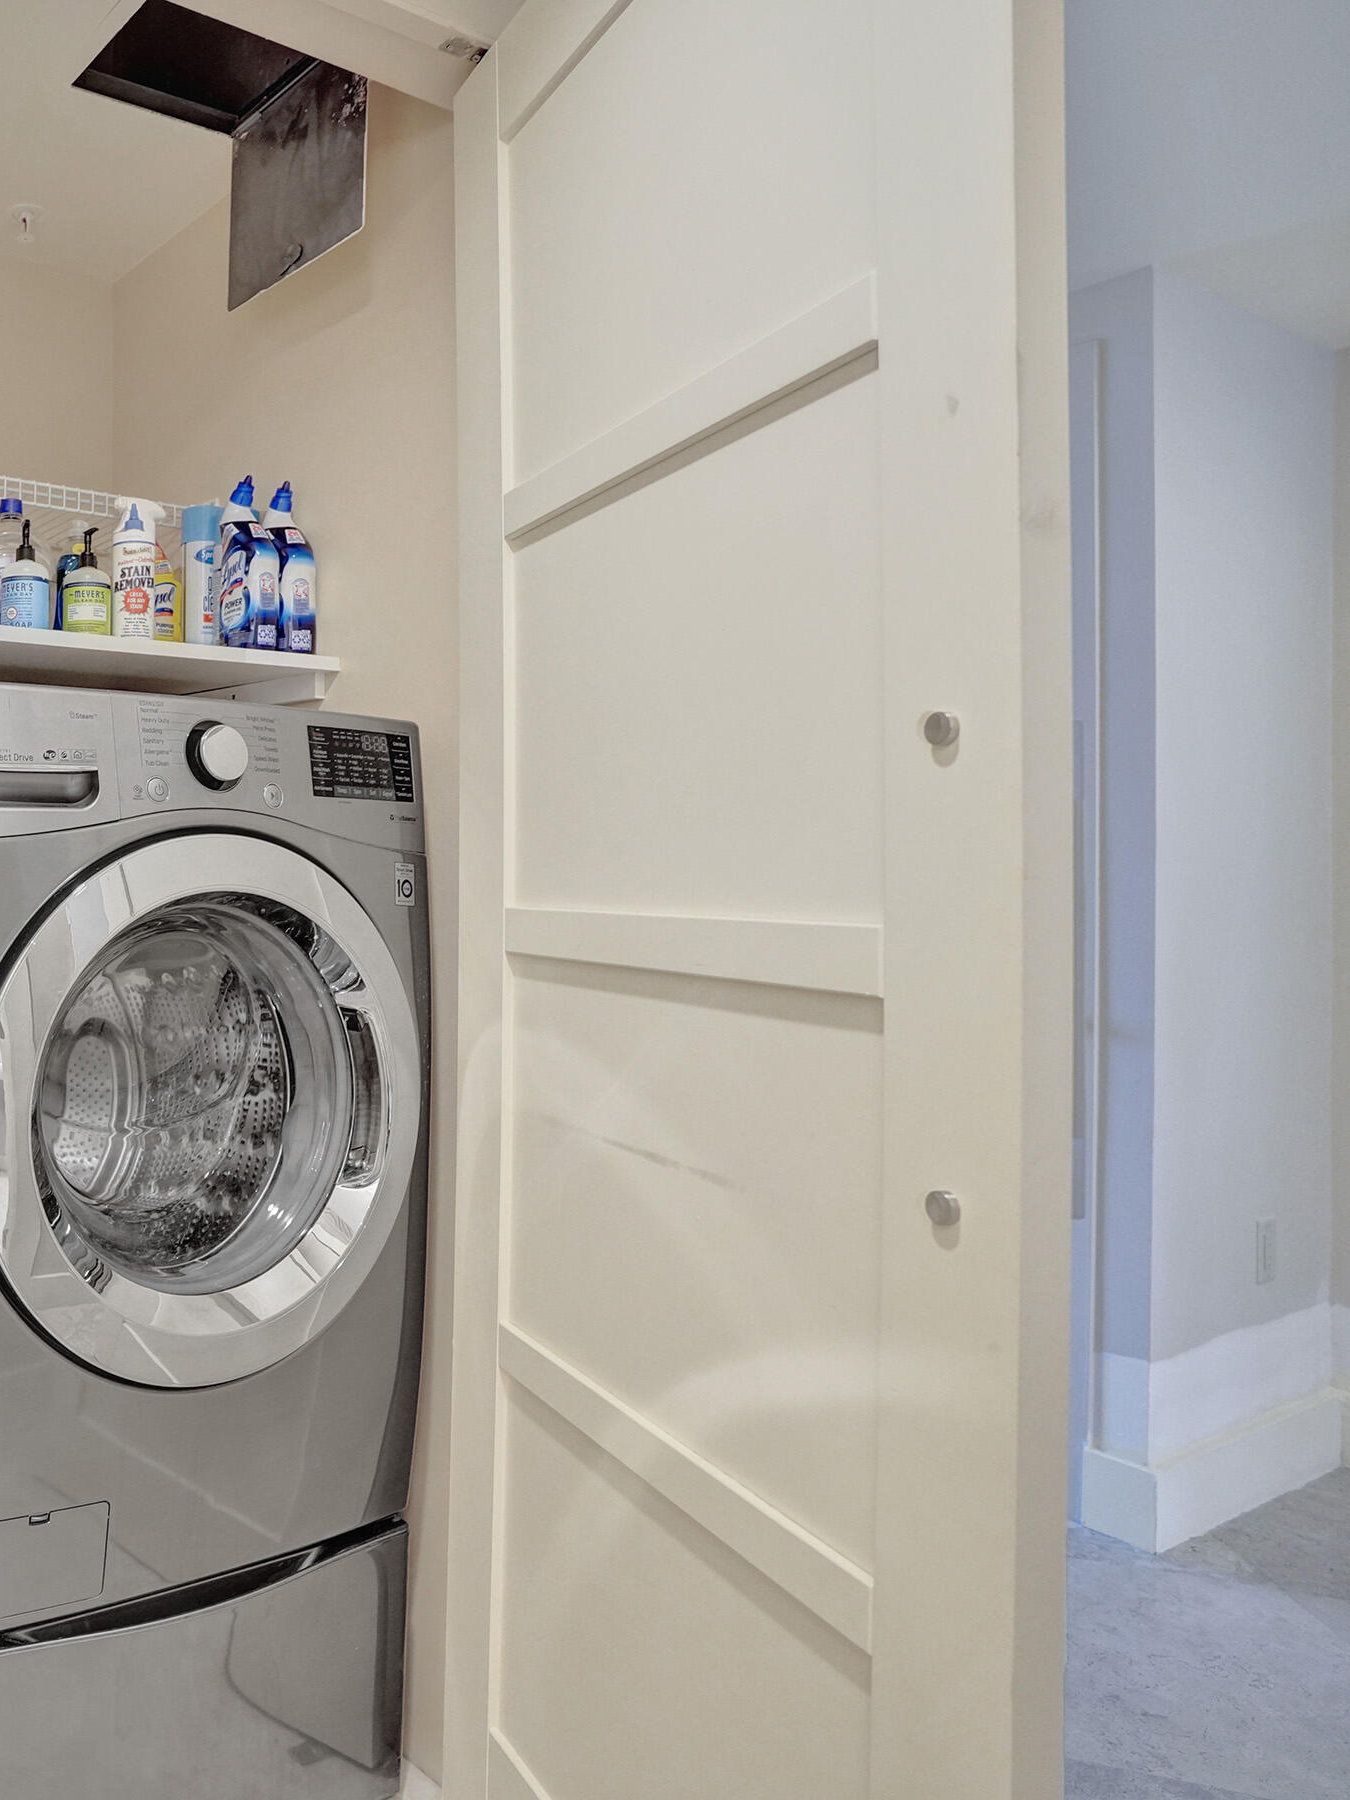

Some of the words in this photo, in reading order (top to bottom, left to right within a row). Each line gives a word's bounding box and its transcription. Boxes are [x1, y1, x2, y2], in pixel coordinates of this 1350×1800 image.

[120, 565, 151, 578] STAIN
[222, 552, 244, 586] Lysol
[74, 590, 105, 599] MEYER'S
[155, 588, 175, 607] ysol
[224, 598, 243, 610] POWER
[14, 753, 34, 762] Drive
[397, 879, 413, 898] 10
